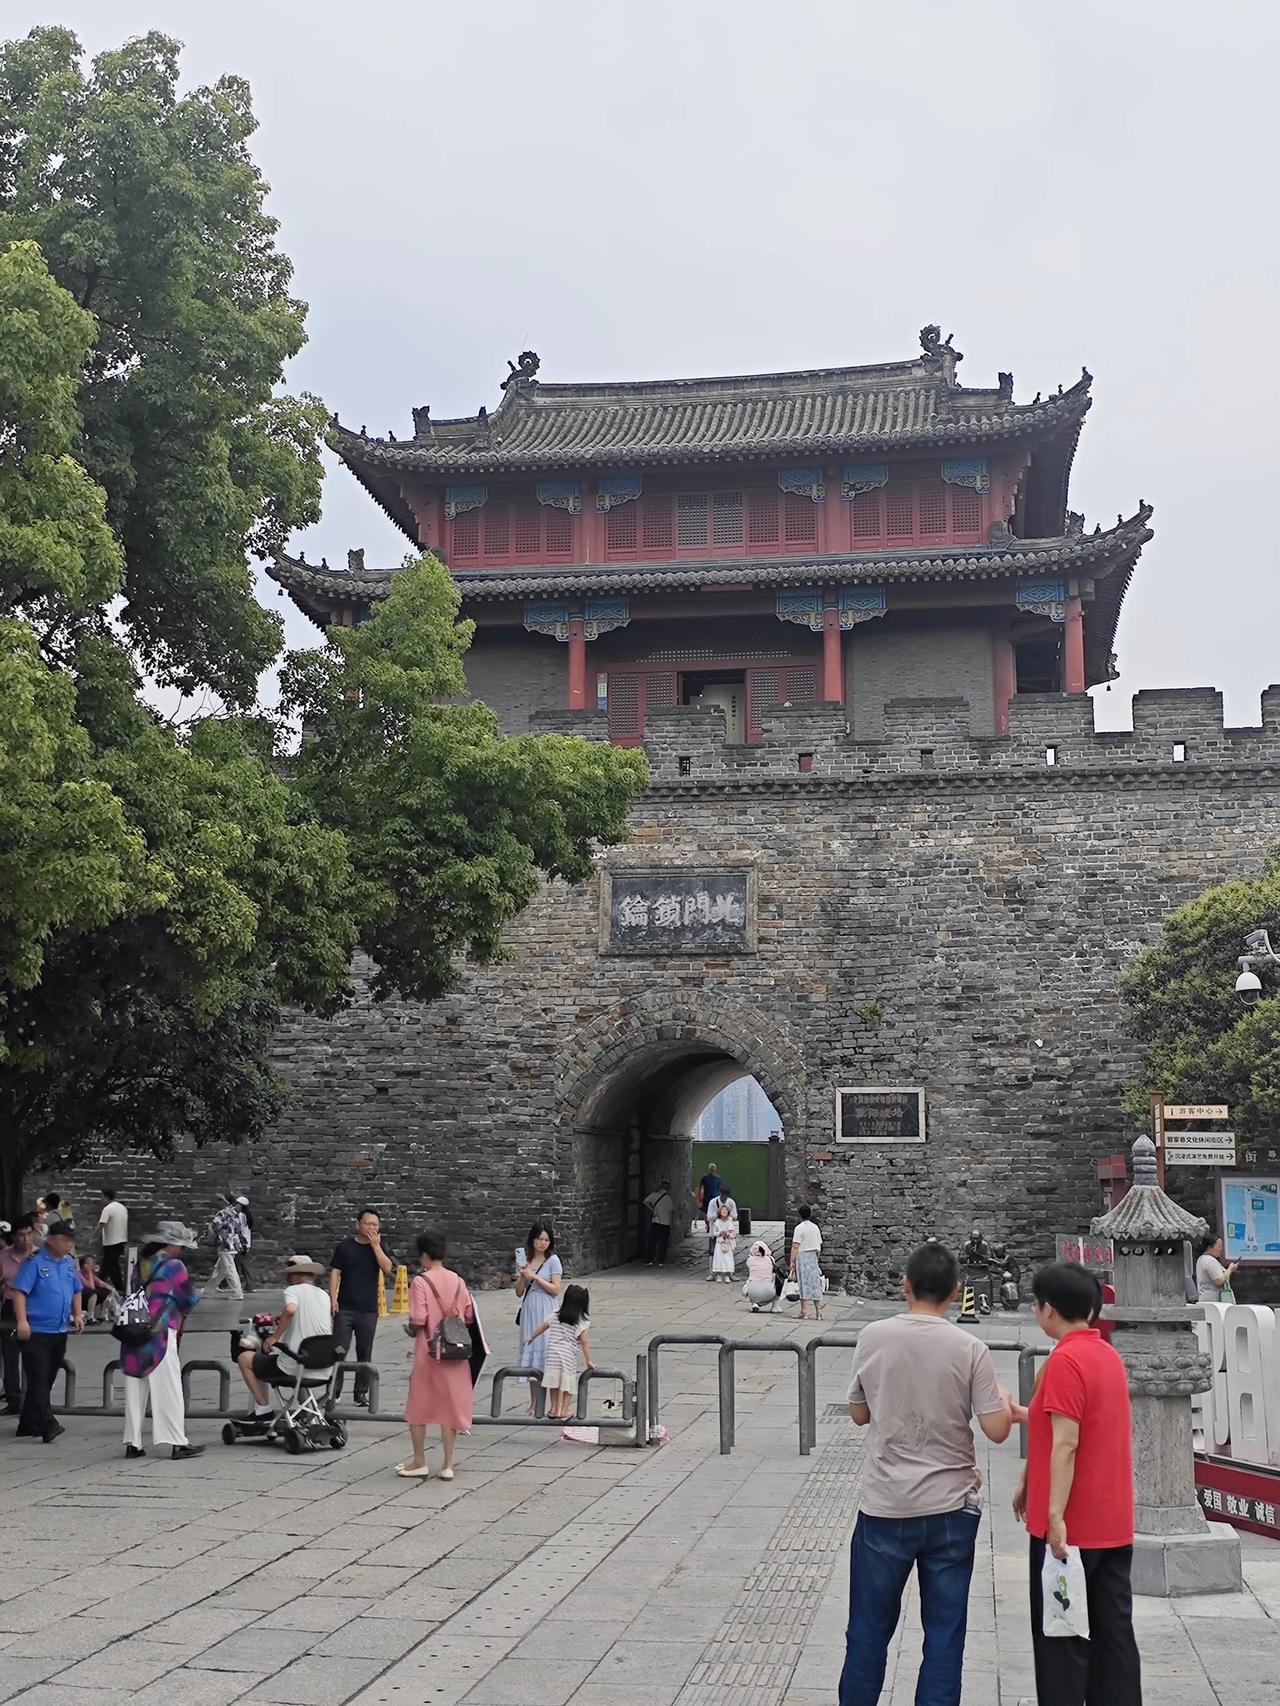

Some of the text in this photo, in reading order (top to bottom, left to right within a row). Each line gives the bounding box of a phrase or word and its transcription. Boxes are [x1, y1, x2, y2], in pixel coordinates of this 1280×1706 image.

[1179, 1107, 1213, 1115] 游客中心
[1203, 1488, 1275, 1525] 爱国 敬业 诚信
